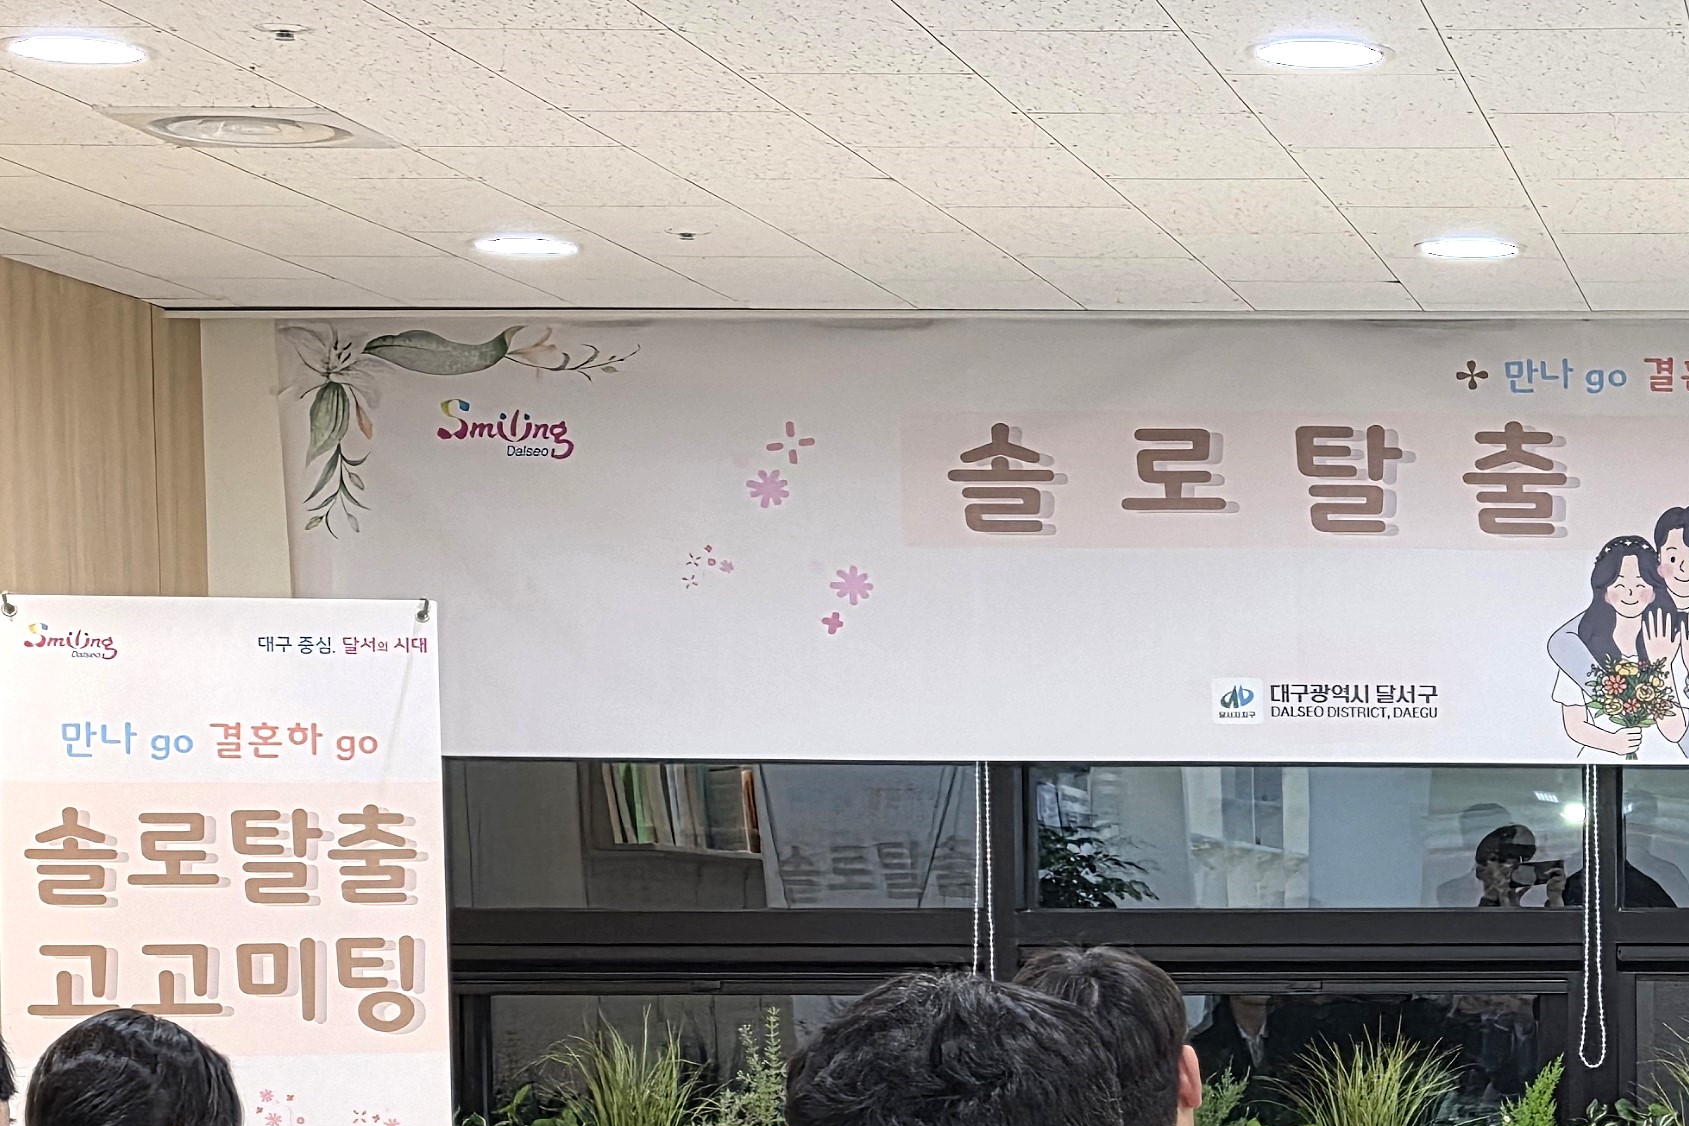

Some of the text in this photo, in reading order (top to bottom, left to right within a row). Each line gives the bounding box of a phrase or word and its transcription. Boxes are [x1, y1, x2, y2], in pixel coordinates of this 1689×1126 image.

[1503, 357, 1574, 394] 만나
[1585, 368, 1628, 394] go
[437, 398, 575, 460] Smiling
[506, 445, 549, 457] Dalseo
[947, 421, 1576, 536] 솔로탈출
[23, 622, 118, 660] Smiling
[258, 636, 292, 653] 대구
[342, 636, 388, 655] 달서의
[393, 637, 428, 654] 시대
[1270, 684, 1438, 704] 대구광역시 달서구
[1271, 706, 1438, 720] DALSEO DISTRICT, DAEGU
[61, 721, 378, 761] 만나 go 결혼하 go
[24, 805, 428, 906] 솔로탈출
[27, 934, 425, 1035] 고고미팅
